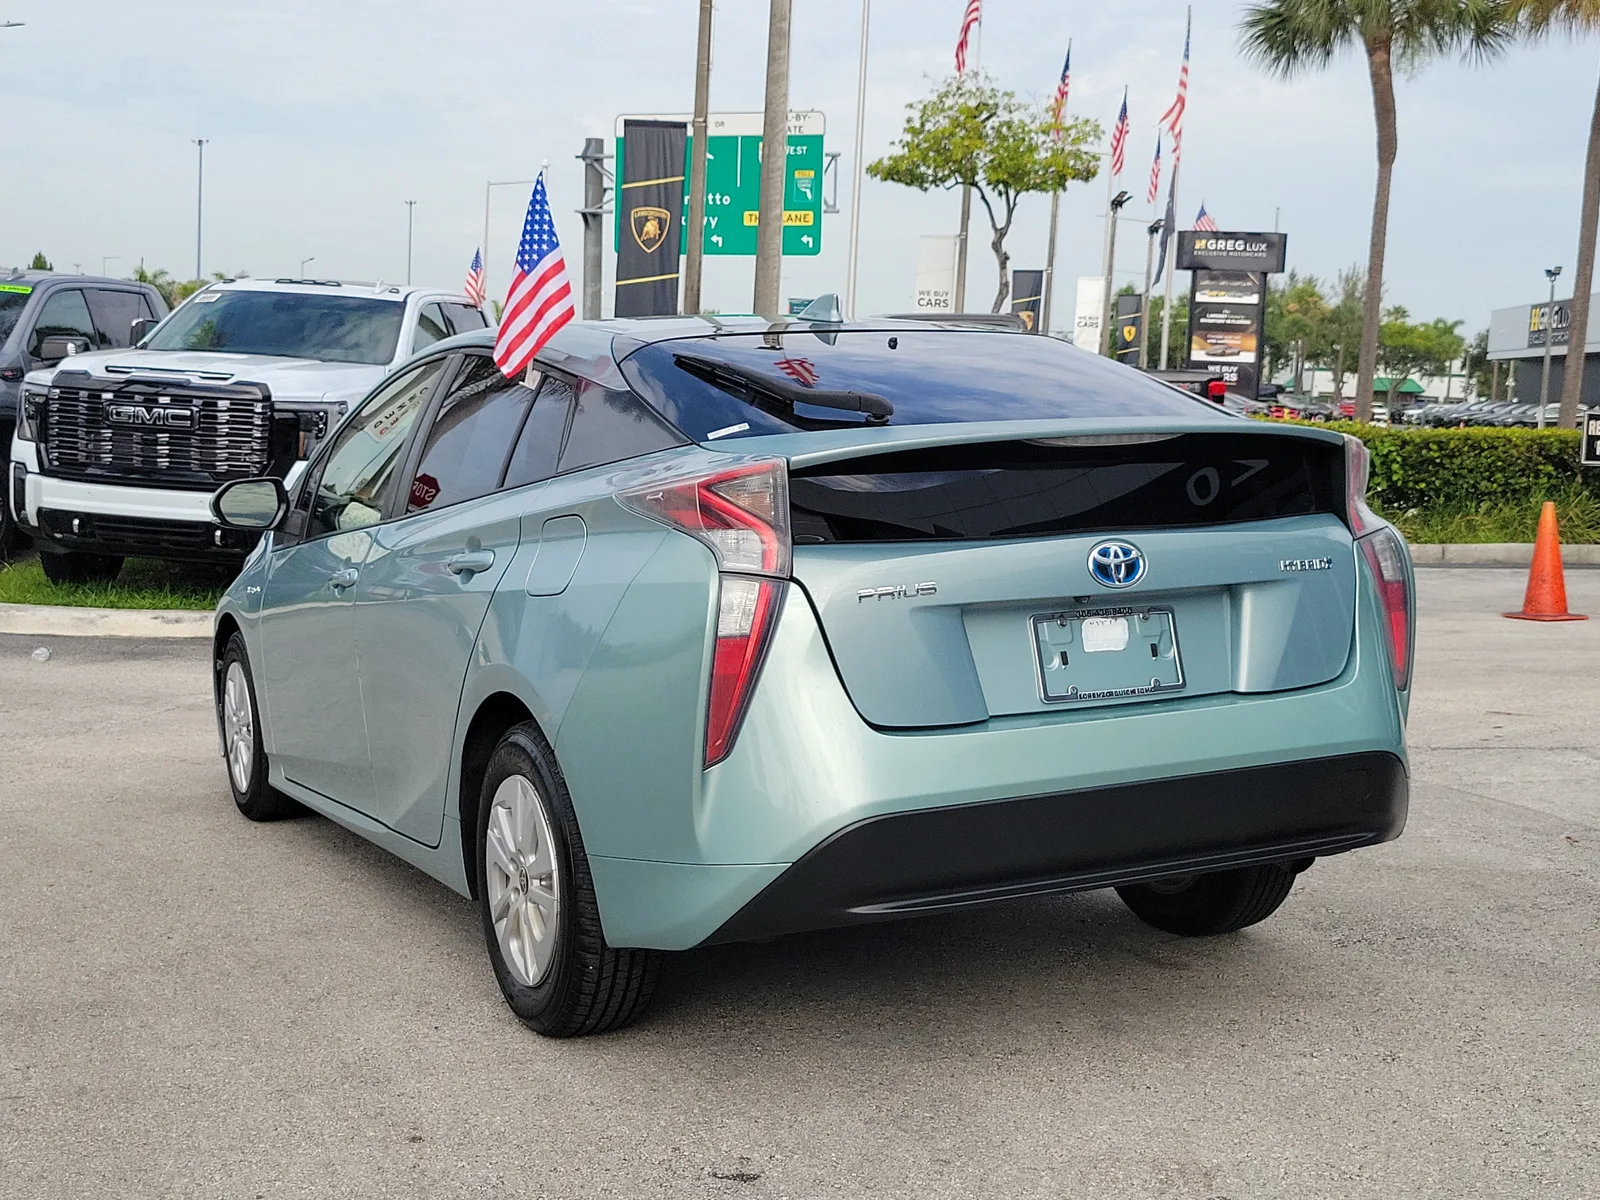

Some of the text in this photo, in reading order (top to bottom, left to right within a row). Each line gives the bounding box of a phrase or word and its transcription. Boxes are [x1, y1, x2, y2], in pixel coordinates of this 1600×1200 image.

[786, 125, 804, 134] ATE
[785, 145, 808, 155] EST
[783, 213, 811, 223] ANE
[918, 289, 949, 298] WE BUY
[917, 297, 949, 308] CARS
[1076, 320, 1099, 329] CARS
[1207, 364, 1239, 374] WE BUY
[1222, 372, 1239, 382] RS
[108, 405, 192, 427] GMC
[857, 580, 938, 604] PRIUS
